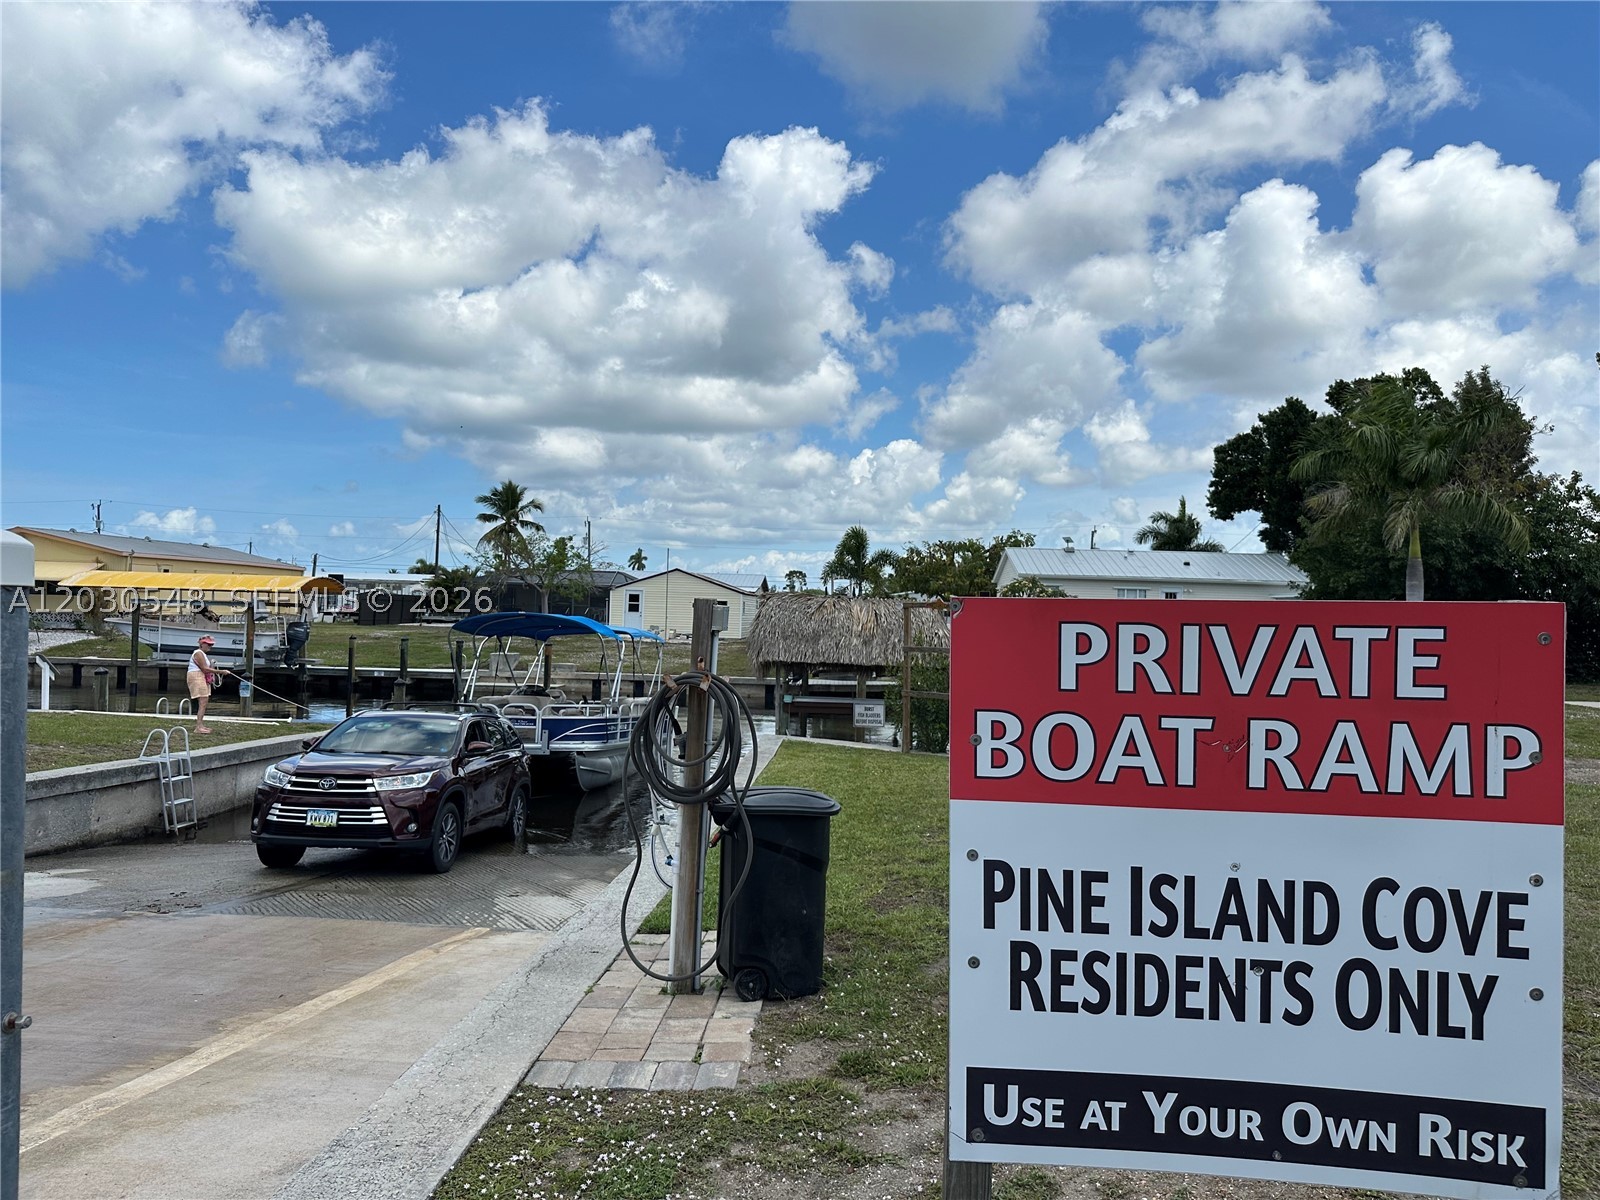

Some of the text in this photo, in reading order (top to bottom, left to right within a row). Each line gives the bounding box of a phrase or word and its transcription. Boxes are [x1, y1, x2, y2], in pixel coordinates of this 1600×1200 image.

[1058, 621, 1447, 699] PRIVATE
[973, 709, 1542, 800] BOAT RAMP
[983, 859, 1530, 960] PINE ISLAND COVE
[1009, 940, 1499, 1041] RESIDENTS ONLY
[983, 1083, 1527, 1168] USE AT YOUR OWN RISK
